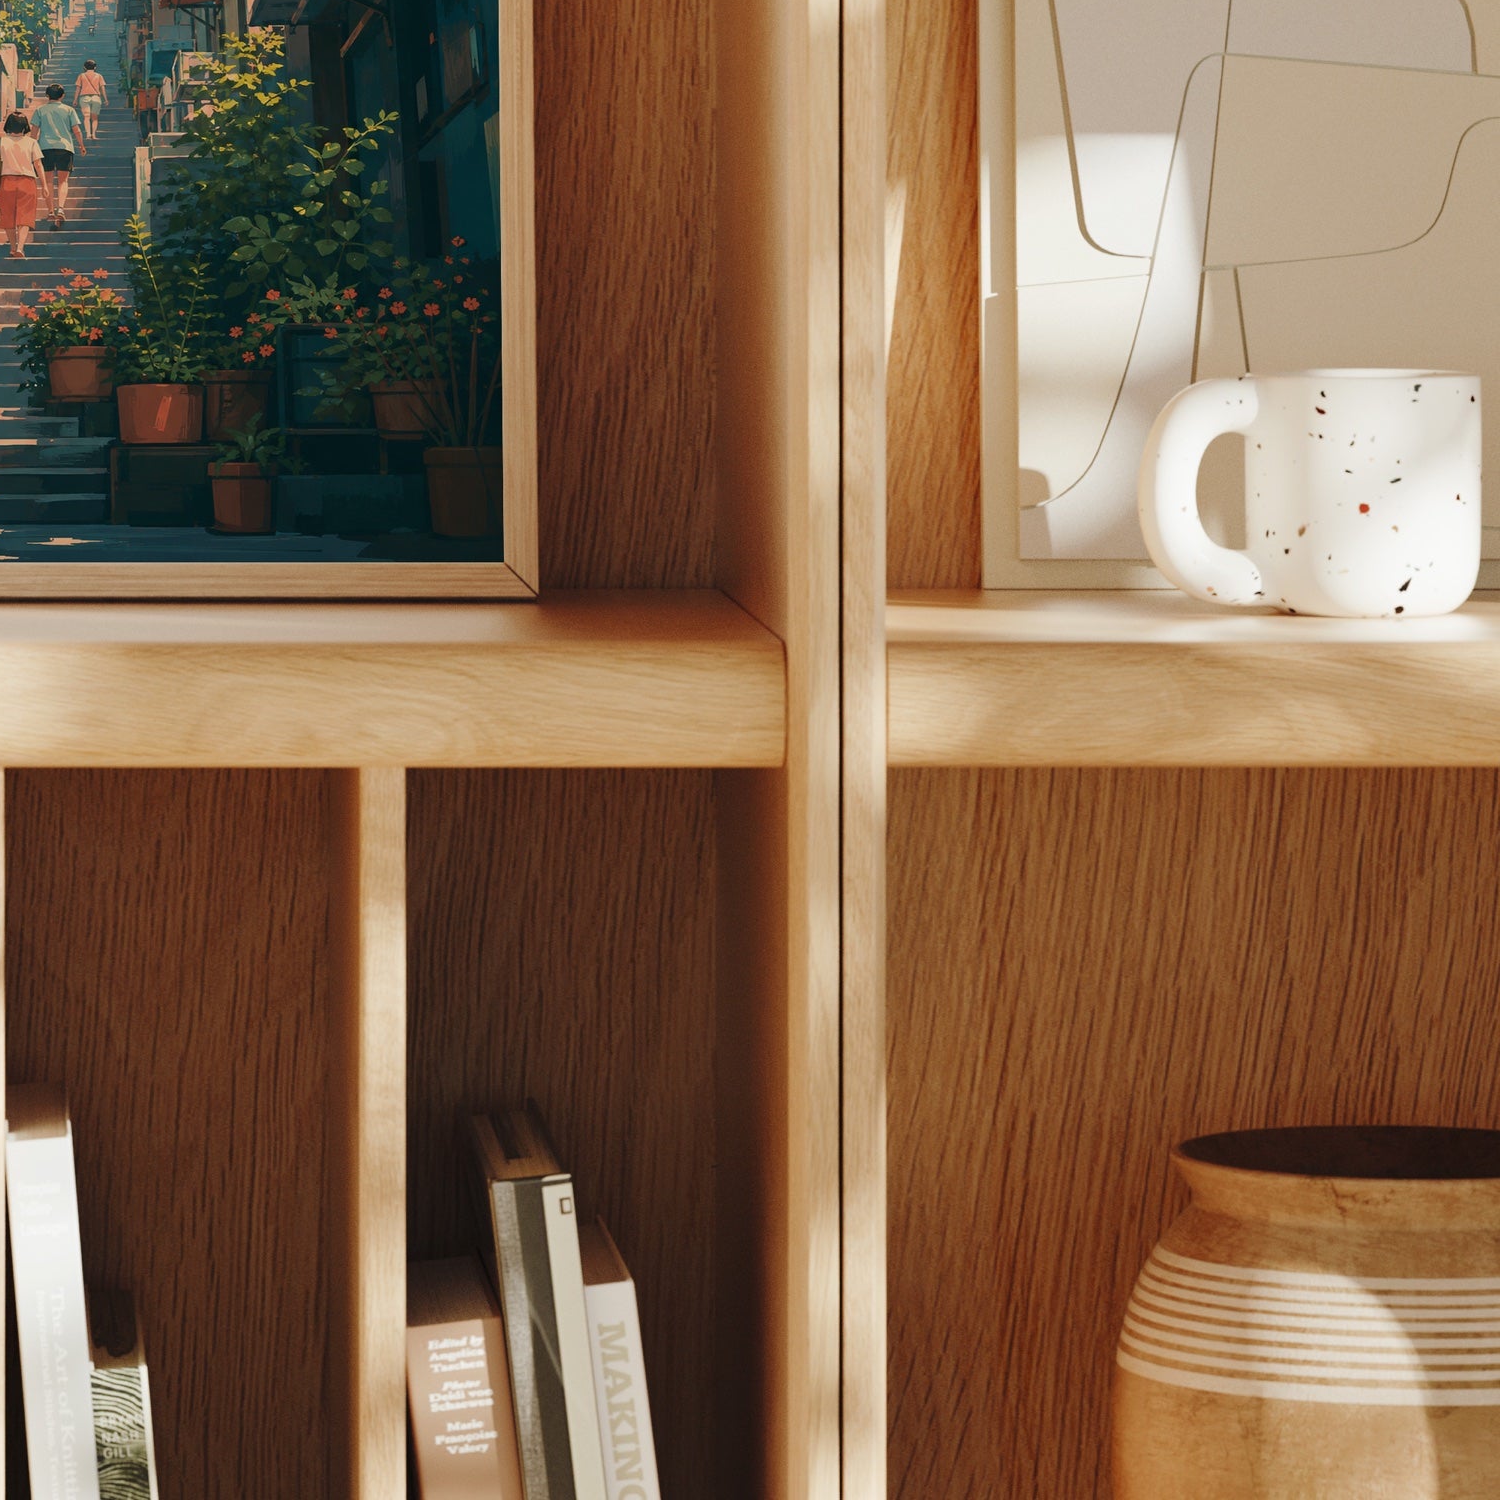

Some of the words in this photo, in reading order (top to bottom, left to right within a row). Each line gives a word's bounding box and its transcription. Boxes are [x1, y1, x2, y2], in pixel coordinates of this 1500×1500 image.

[54, 1341, 69, 1383] Art
[59, 1390, 74, 1416] of
[102, 1446, 134, 1459] GILL
